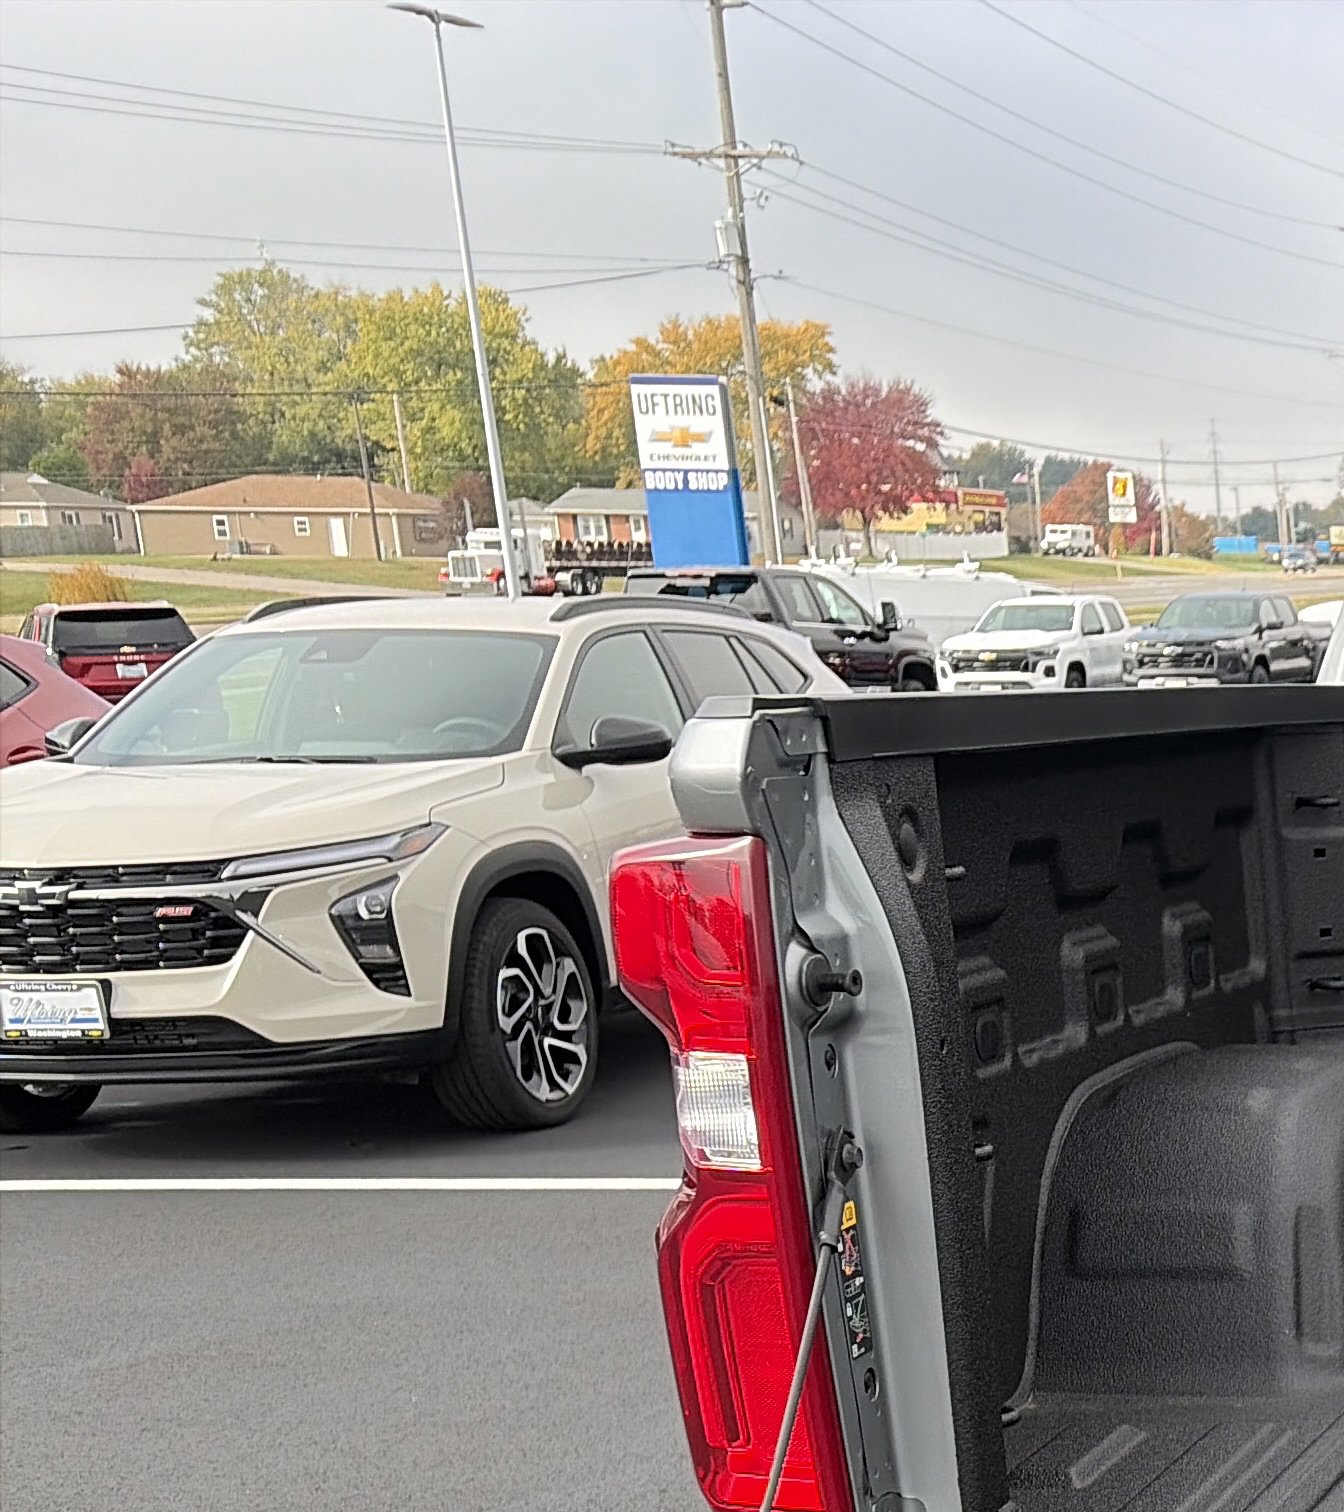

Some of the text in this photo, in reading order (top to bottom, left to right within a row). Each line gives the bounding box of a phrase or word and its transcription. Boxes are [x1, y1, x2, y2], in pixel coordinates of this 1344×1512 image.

[636, 392, 717, 416] UFTRING
[649, 453, 717, 463] CHEVROLET
[644, 470, 728, 491] BODY SHOP
